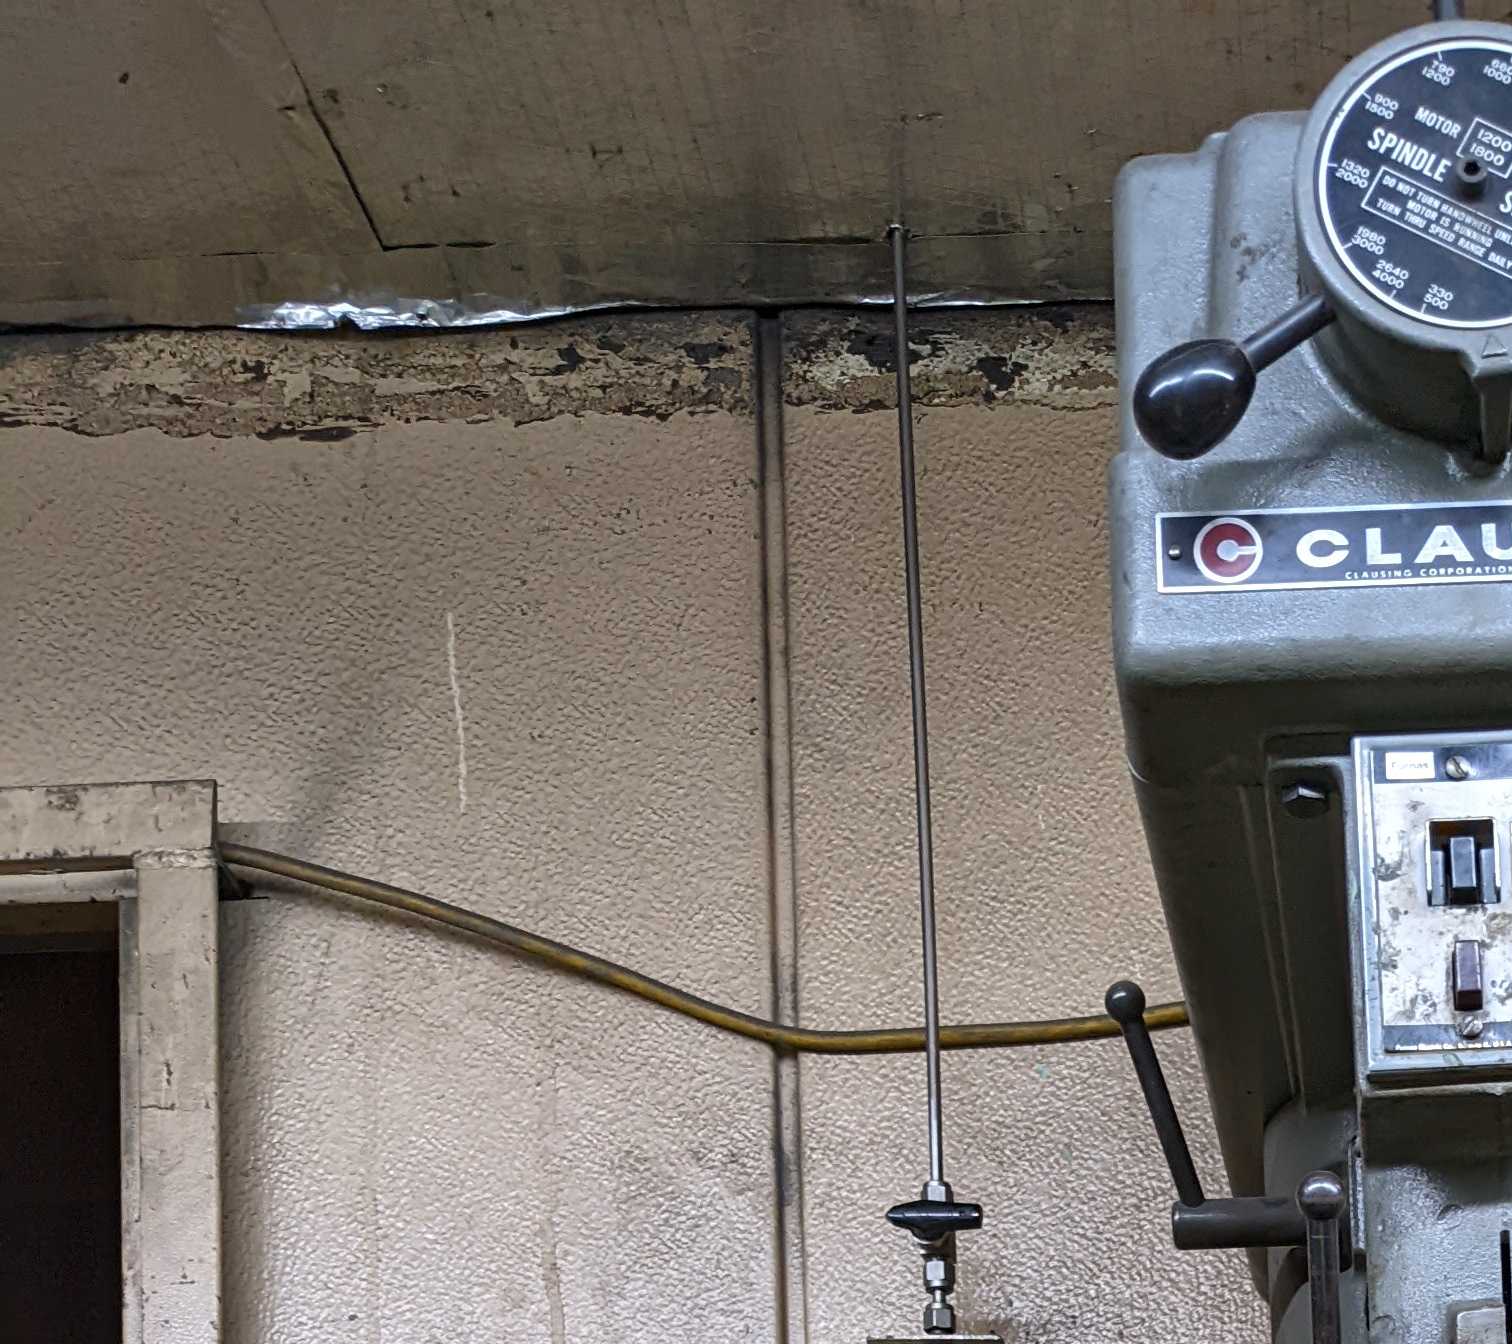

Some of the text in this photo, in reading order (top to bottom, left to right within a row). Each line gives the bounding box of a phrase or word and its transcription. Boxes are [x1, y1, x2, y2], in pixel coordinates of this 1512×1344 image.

[1422, 67, 1450, 85] 1200
[1429, 60, 1454, 76] 790
[1484, 65, 1511, 84] 1000
[1365, 100, 1394, 119] 1500
[1375, 94, 1398, 110] 900
[1415, 107, 1461, 138] MOTOR
[1478, 129, 1512, 152] 1200
[1368, 128, 1451, 182] SPINDLE
[1470, 143, 1504, 165] 1800
[1341, 159, 1369, 177] 1320
[1336, 168, 1368, 188] 2000
[1383, 175, 1396, 187] DO
[1397, 182, 1416, 196] NOT
[1415, 192, 1440, 209] TURN
[1377, 198, 1401, 215] TURN
[1405, 212, 1427, 228] THRU
[1429, 224, 1455, 242] SPEED
[1407, 200, 1438, 220] MOTOR
[1440, 217, 1450, 227] IS
[1352, 234, 1384, 254] 3000
[1356, 227, 1385, 245] 1980
[1372, 270, 1405, 288] 4000
[1376, 260, 1408, 279] 2640
[1424, 294, 1448, 309] 500
[1429, 285, 1453, 301] 330
[1344, 570, 1413, 581] CLAUSING
